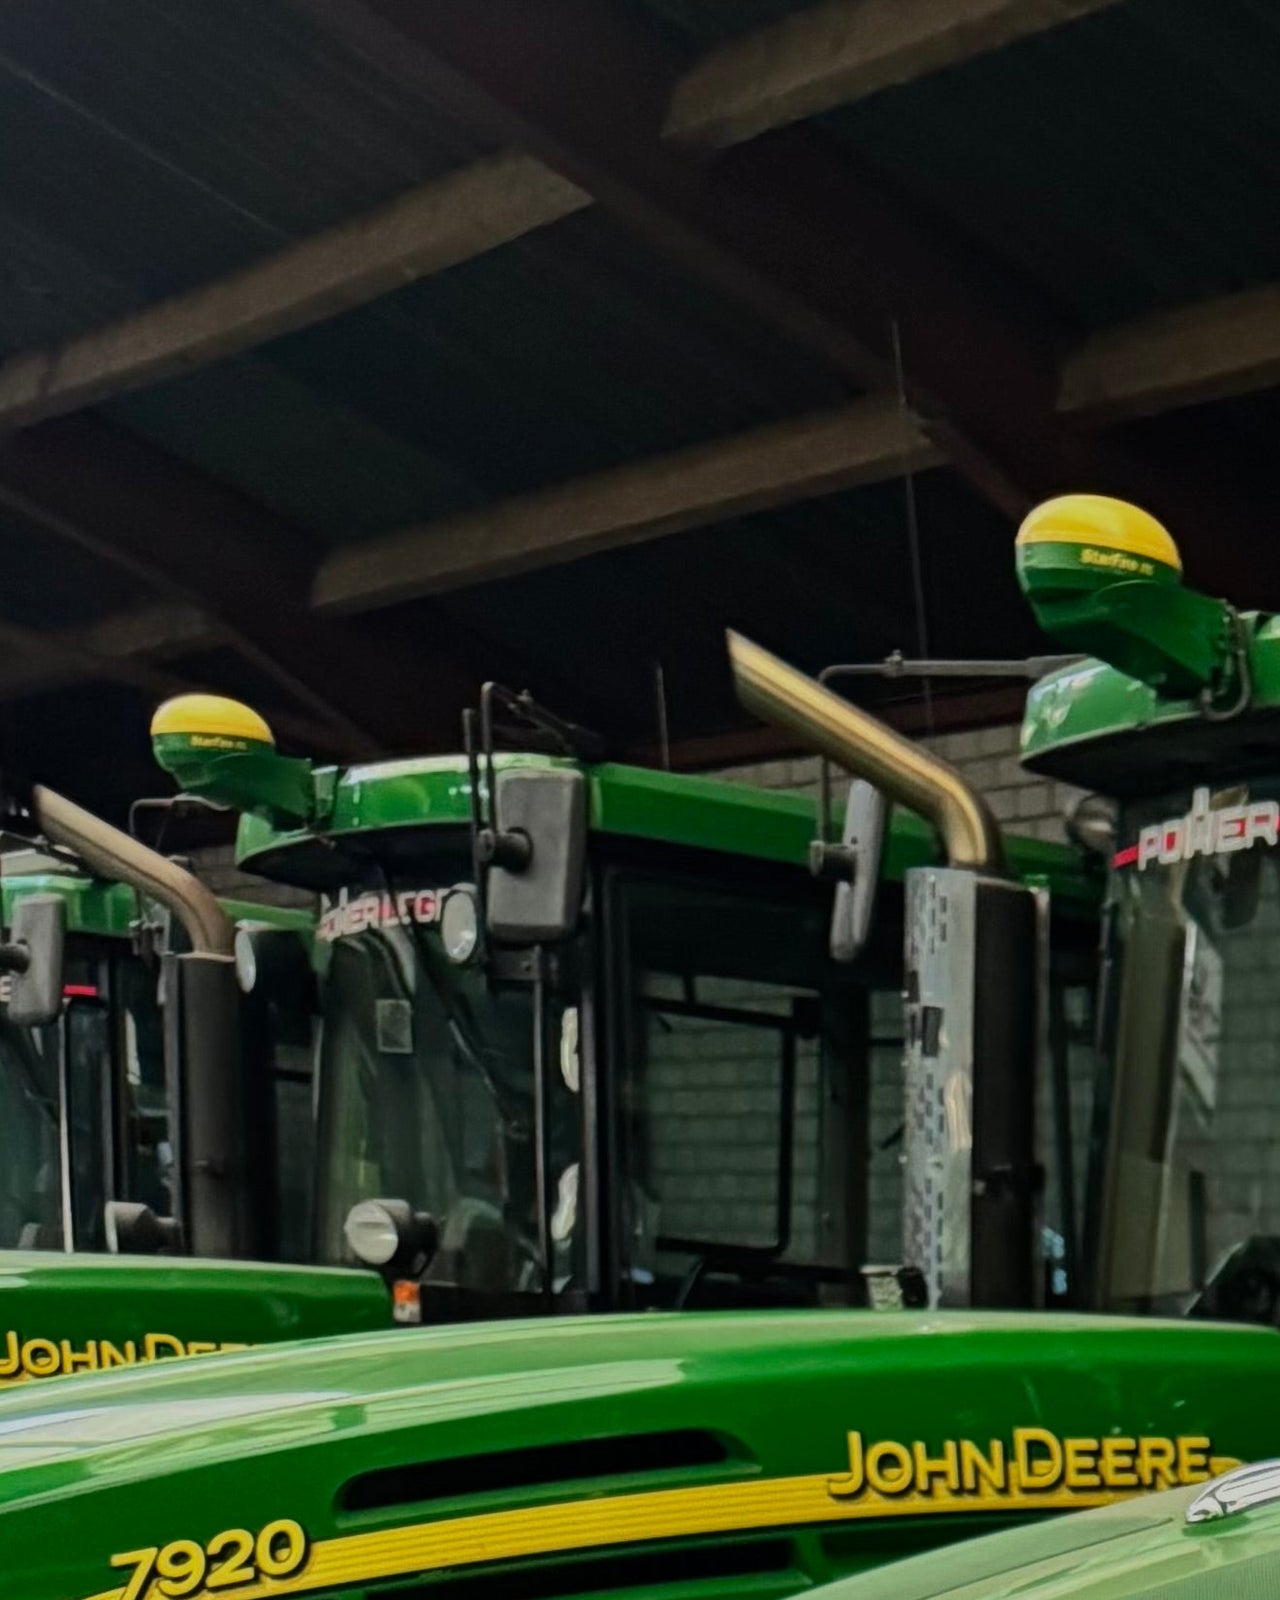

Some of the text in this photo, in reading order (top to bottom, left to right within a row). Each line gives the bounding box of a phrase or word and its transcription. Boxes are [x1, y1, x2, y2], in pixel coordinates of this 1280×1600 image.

[1138, 786, 1279, 870] POWER
[828, 1427, 1211, 1496] JOHN DEERE
